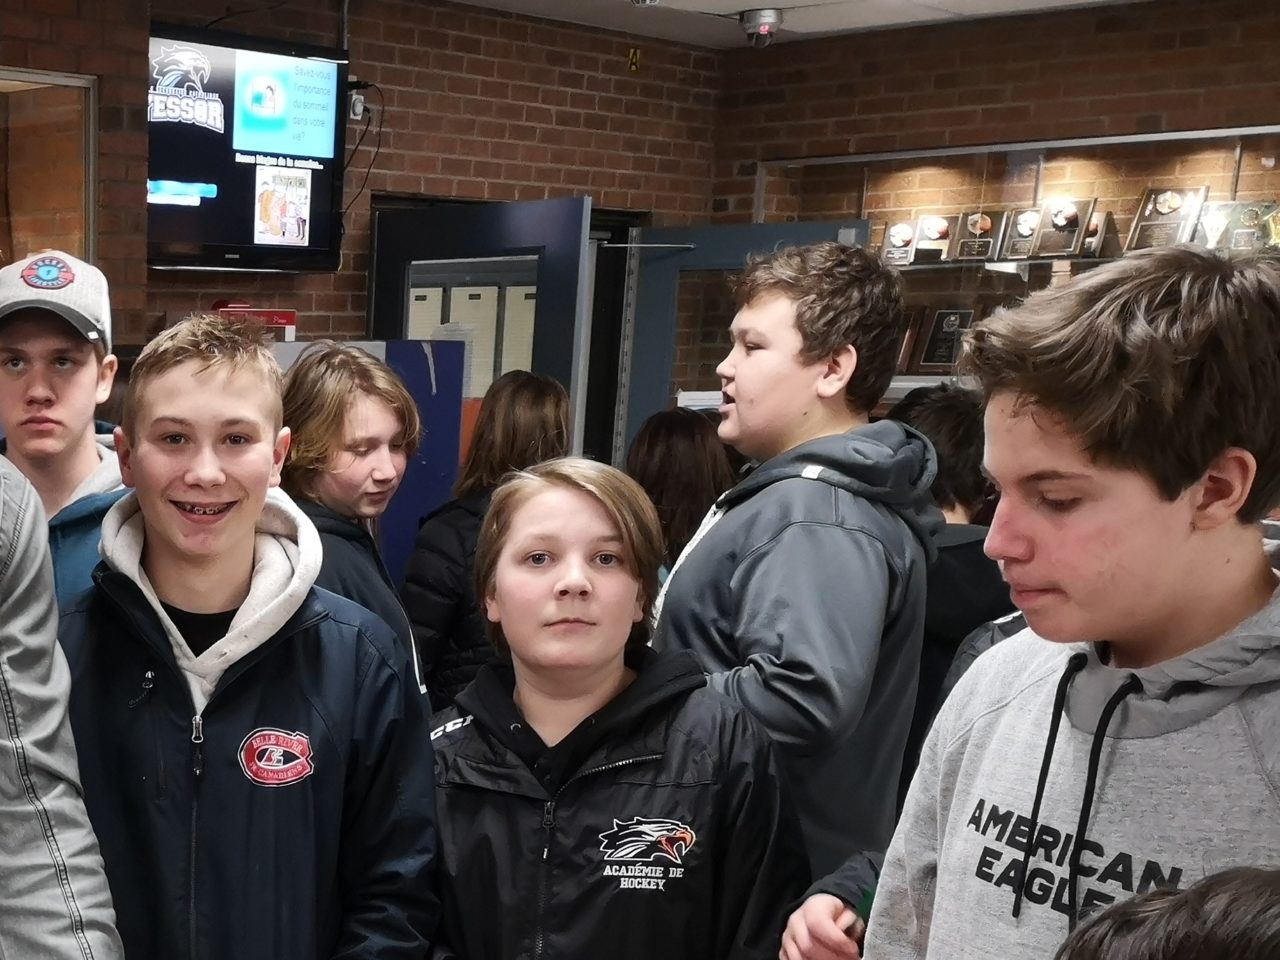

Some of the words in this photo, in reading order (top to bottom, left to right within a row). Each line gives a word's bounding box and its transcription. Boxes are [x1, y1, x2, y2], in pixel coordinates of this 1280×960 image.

[252, 735, 276, 749] BELLE
[277, 736, 303, 753] RIVER
[258, 765, 303, 779] CANADIENS
[967, 798, 1183, 895] AMERICAN
[603, 862, 664, 877] ACADÉMIE
[669, 867, 684, 878] DE
[620, 878, 666, 891] HOCKEY
